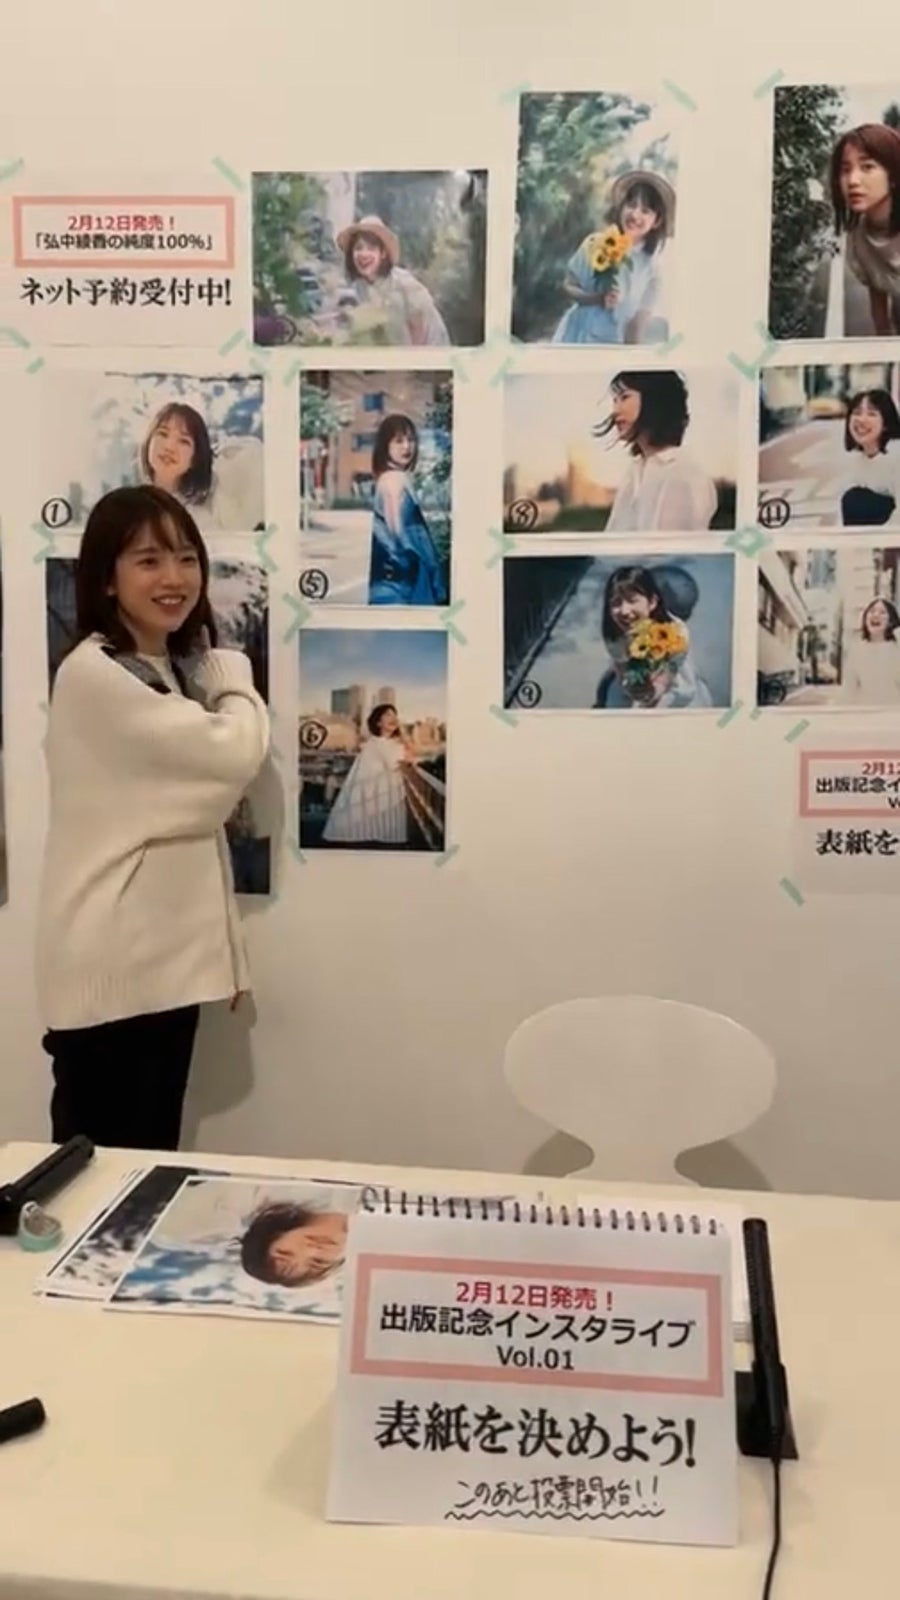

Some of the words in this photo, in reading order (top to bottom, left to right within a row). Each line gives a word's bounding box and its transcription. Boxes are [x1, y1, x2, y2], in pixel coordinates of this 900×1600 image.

[20, 277, 232, 307] ネット予約受付中!
[816, 828, 900, 856] 表紙を
[456, 1281, 614, 1311] 2月12日発売！
[379, 1303, 697, 1349] 出版記念インスタライブ
[496, 1345, 575, 1371] Vol.01
[374, 1399, 697, 1469] 表紙を決めよう!
